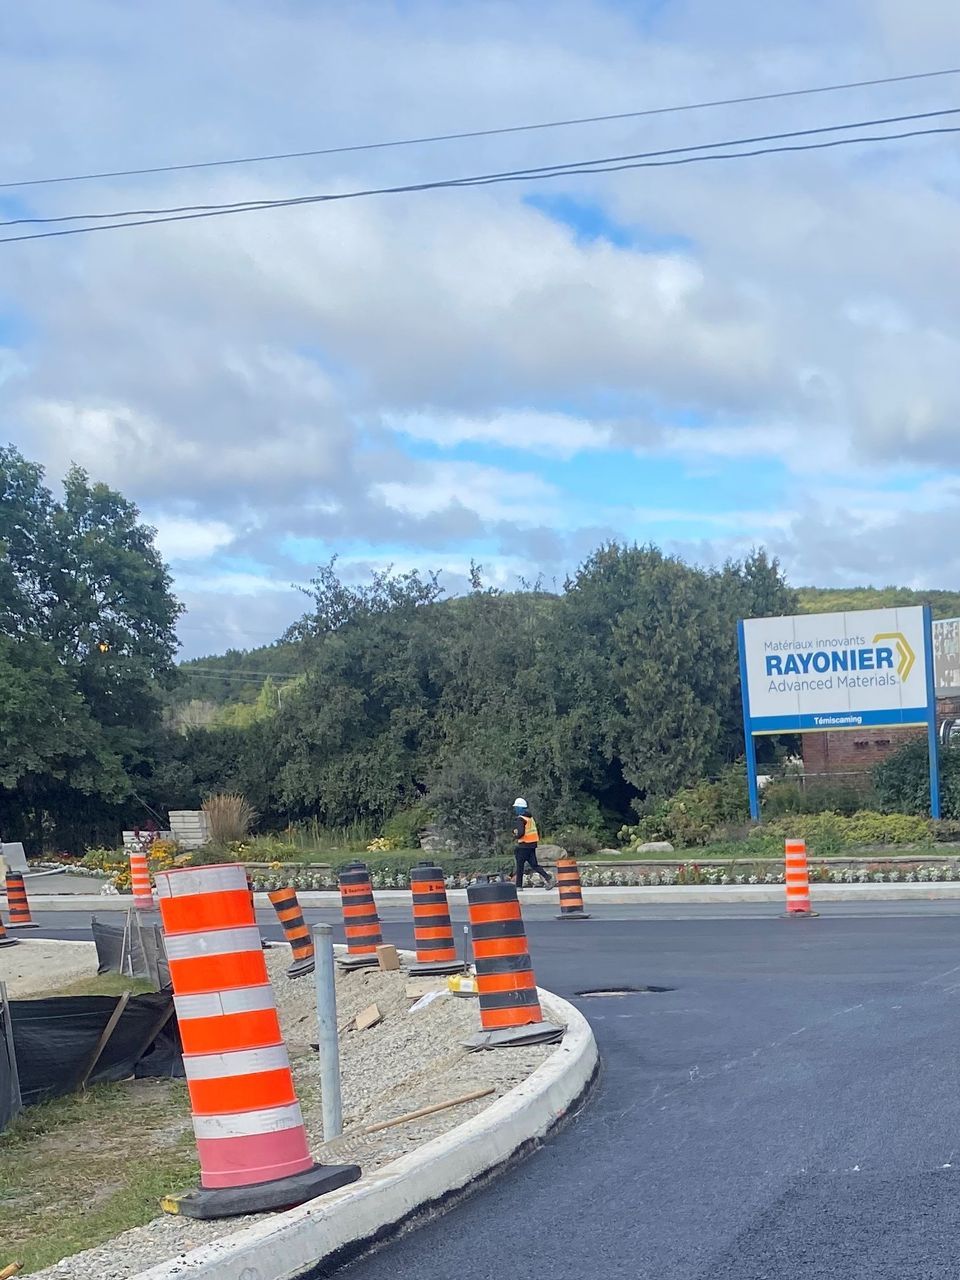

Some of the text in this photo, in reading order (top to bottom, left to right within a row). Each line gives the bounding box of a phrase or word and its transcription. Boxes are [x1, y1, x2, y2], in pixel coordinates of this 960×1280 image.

[764, 636, 865, 651] Matériaux innovants
[766, 647, 893, 676] RAYONIER
[768, 673, 896, 693] Advanced Materials
[814, 715, 862, 725] Témiscaming
